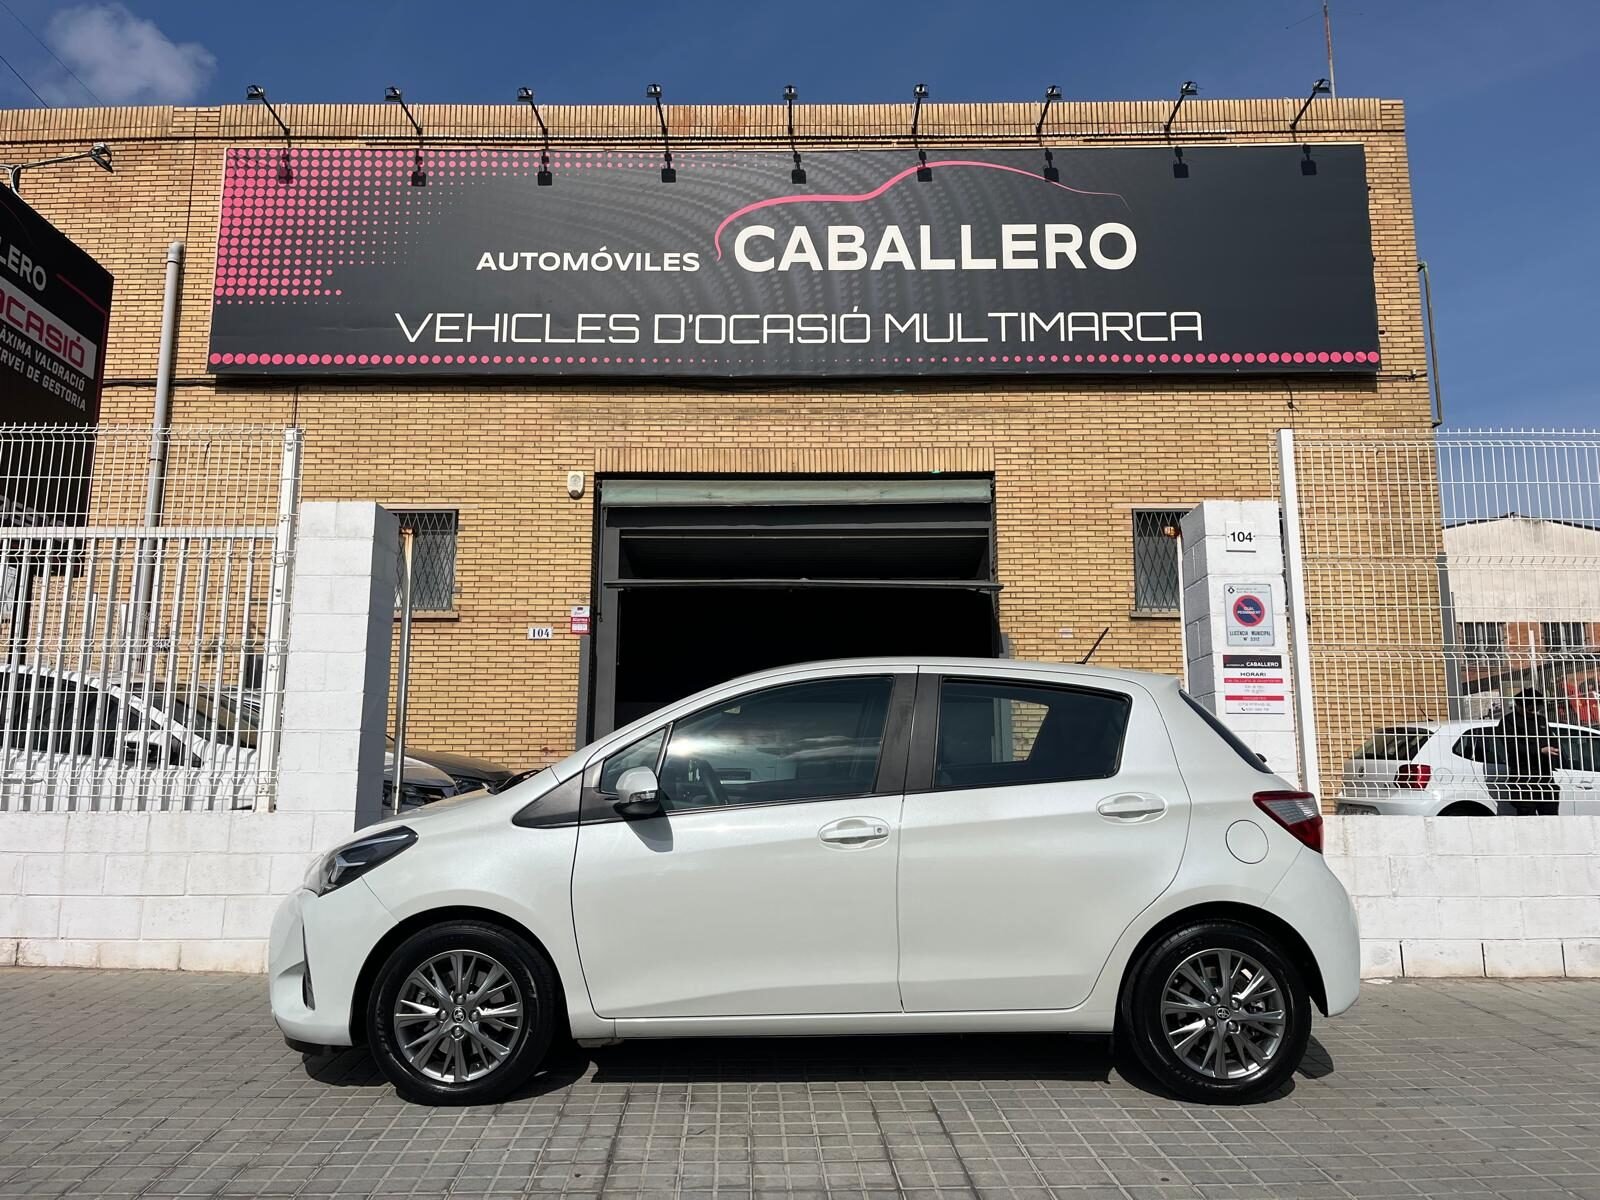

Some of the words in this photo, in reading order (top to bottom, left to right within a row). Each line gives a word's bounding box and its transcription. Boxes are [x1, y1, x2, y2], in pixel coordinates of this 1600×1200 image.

[476, 245, 700, 271] AUTOMÓVILES
[734, 222, 1137, 272] CABALLERO
[395, 312, 640, 344] VEHICLES
[653, 305, 870, 344] D'OCASIÓ
[885, 310, 1203, 343] MULTIMARCA
[26, 365, 40, 384] DE
[42, 374, 87, 412] GESTORIA
[34, 349, 86, 392] VALORACIÓ
[1230, 531, 1253, 543] 104
[532, 628, 550, 638] 104
